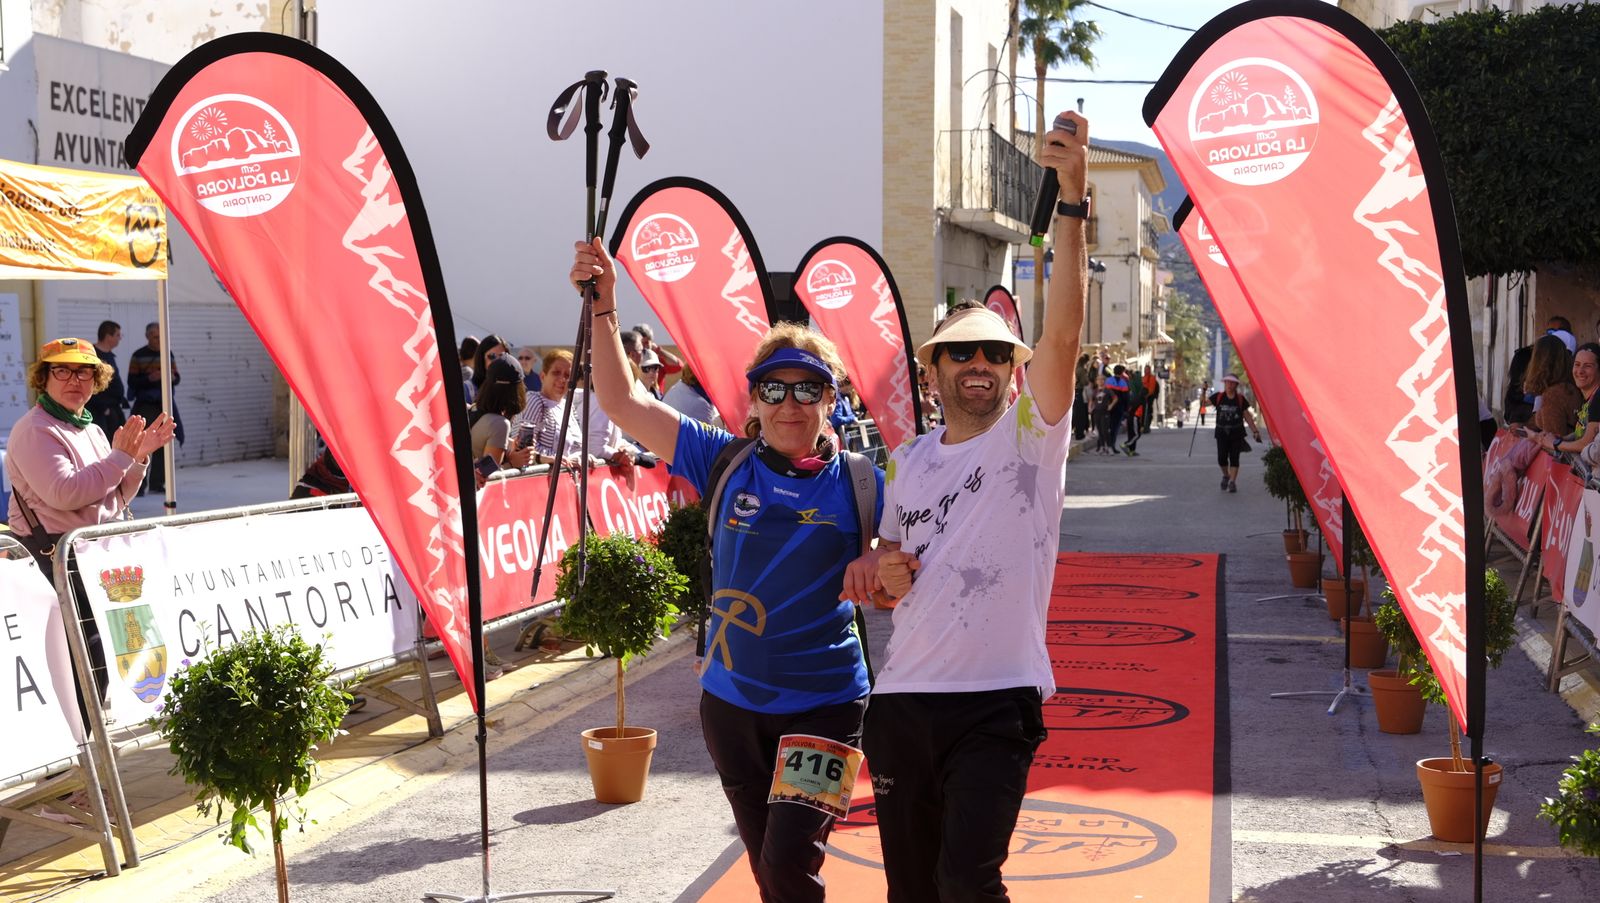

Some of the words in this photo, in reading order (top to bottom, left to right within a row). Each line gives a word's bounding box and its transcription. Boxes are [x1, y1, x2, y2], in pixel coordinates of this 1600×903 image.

[51, 81, 147, 124] EXCELENT
[54, 131, 132, 170] AYUNTA
[479, 514, 568, 579] VEOLIA
[173, 550, 352, 598] AYUNTAMIENTO
[361, 544, 387, 566] DE
[3, 613, 22, 641] E
[178, 573, 403, 657] CANTORIA
[785, 750, 844, 782] 416
[1032, 762, 1138, 773] Ayunta
[1078, 819, 1130, 829] LA
